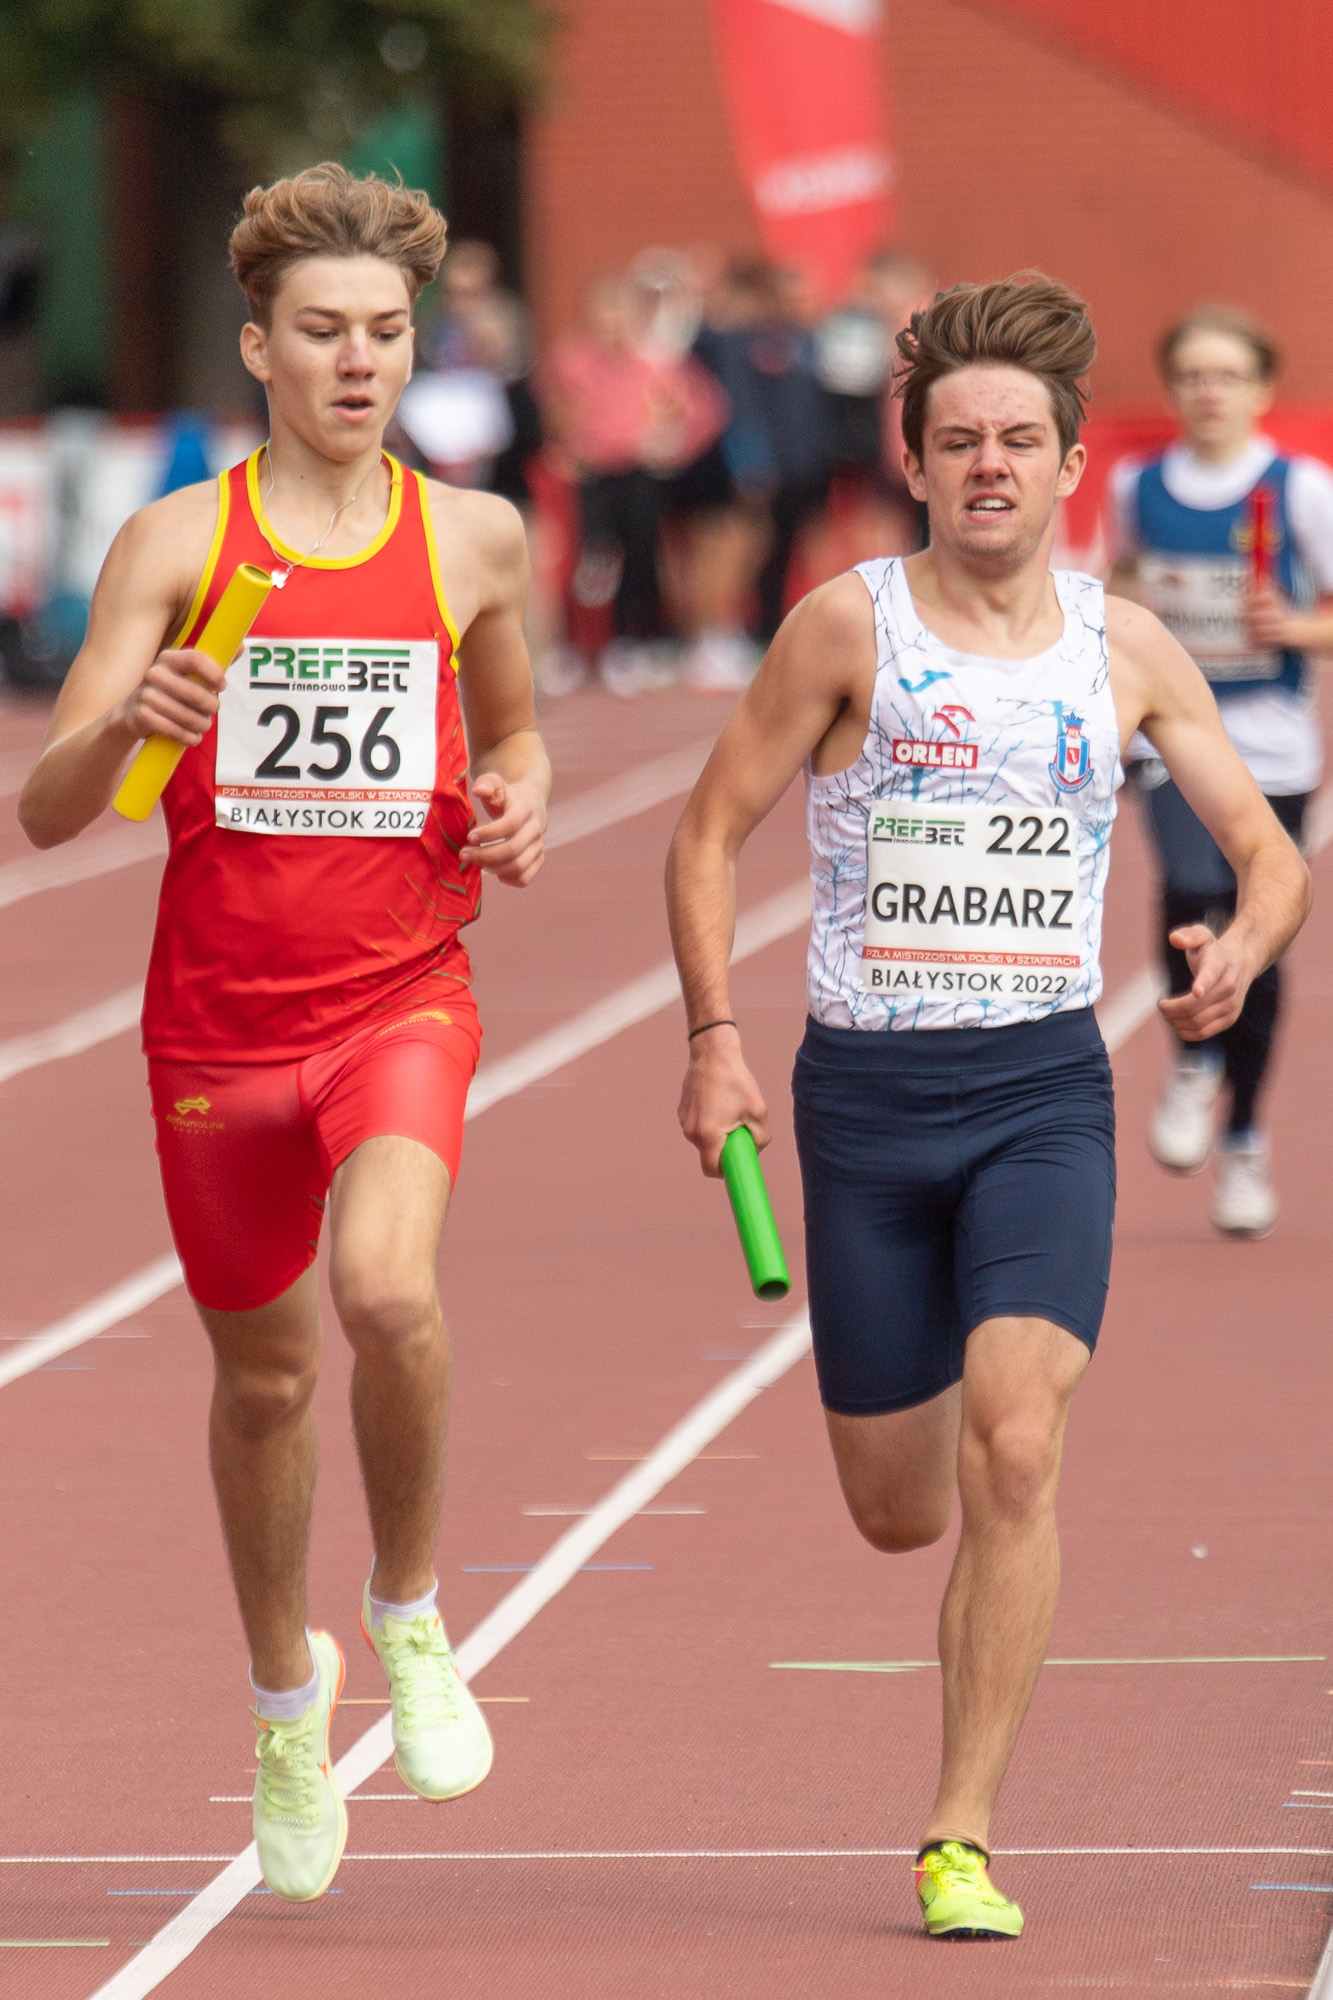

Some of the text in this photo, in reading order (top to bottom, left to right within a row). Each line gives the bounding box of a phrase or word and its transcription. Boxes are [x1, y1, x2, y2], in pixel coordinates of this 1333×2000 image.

[249, 646, 411, 693] PREFBET
[254, 703, 401, 782] 256
[895, 742, 974, 768] ORLEN
[222, 788, 249, 797] PZLA
[251, 789, 326, 800] MISTRZOSTWA
[327, 791, 364, 800] POLSKI
[366, 791, 376, 800] W
[230, 806, 426, 830] BIAŁYSTOK 2022
[873, 816, 966, 846] PREFBET
[985, 814, 1071, 857] 222
[871, 882, 1074, 930] GRABARZ
[866, 949, 1077, 967] PZLA MISTRZOSTWA POLSKI W SZTAFETACH
[871, 968, 1068, 995] BIAŁYSTOK 2022
